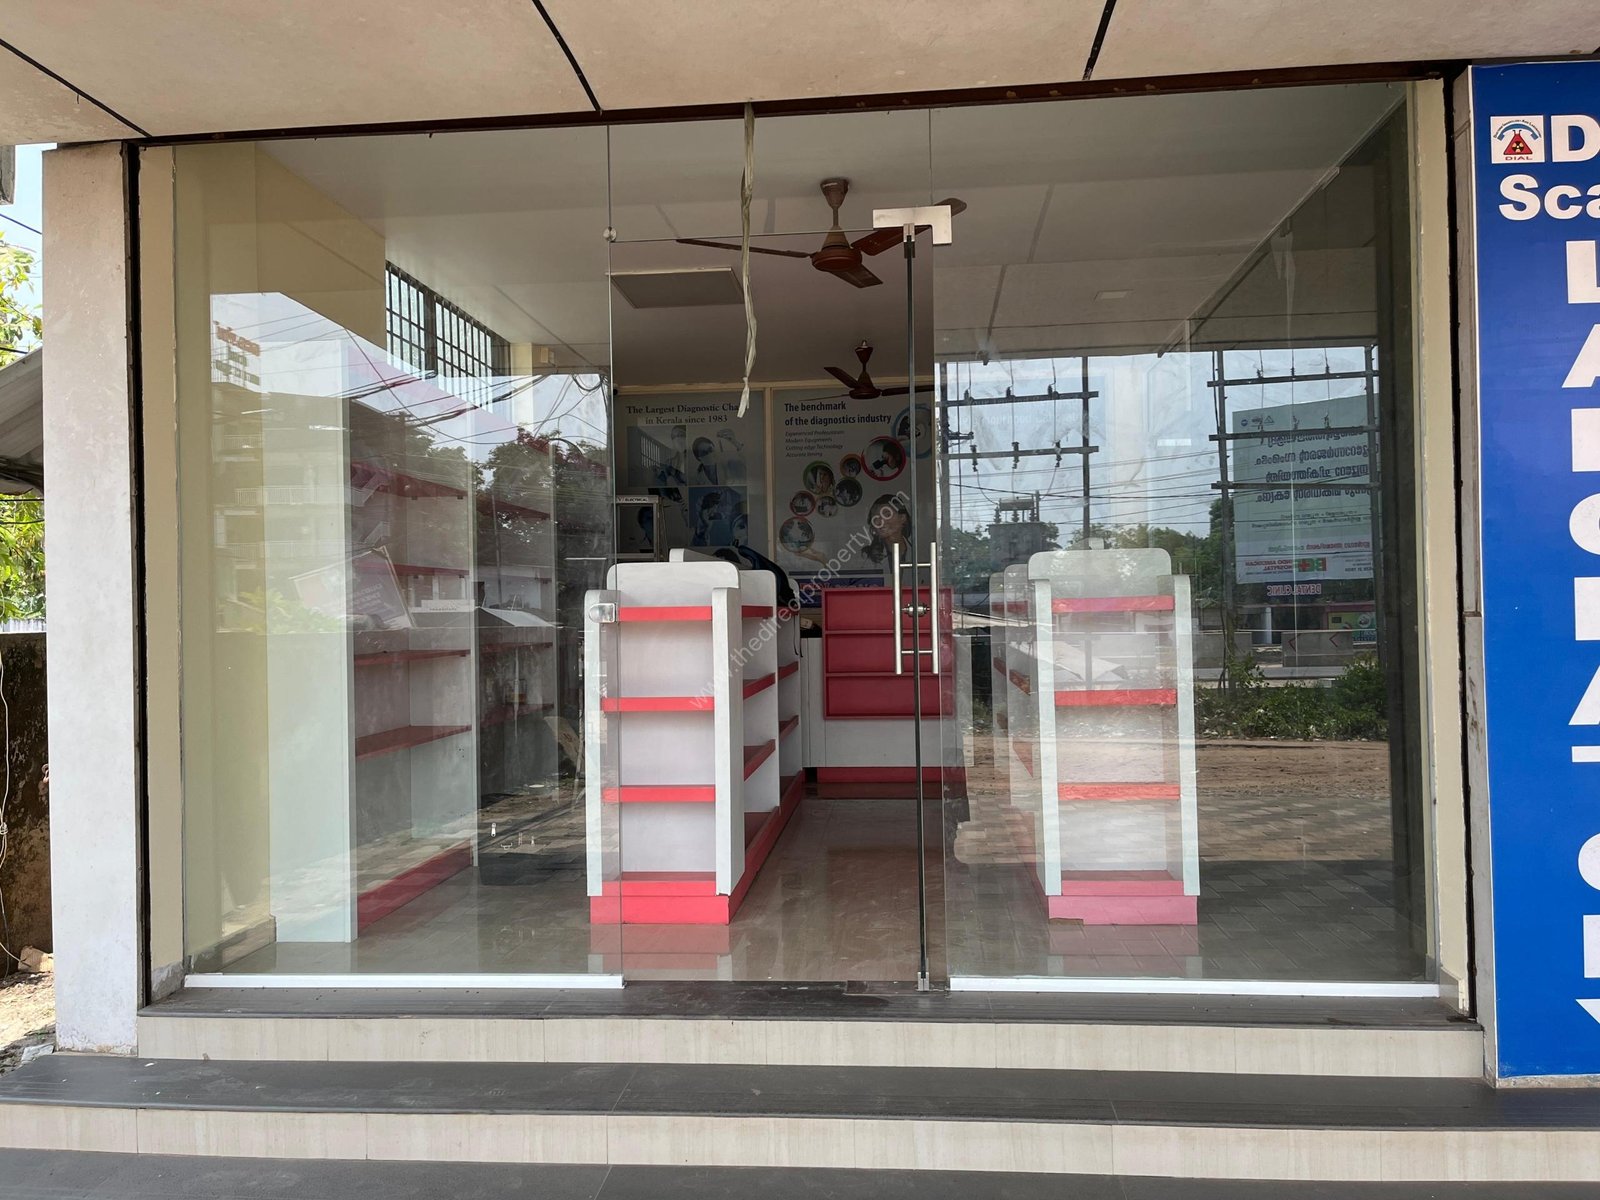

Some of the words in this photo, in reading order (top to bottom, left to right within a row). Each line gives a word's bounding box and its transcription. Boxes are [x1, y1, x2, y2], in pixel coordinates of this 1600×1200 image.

[626, 405, 642, 414] The
[645, 404, 675, 415] Largest
[677, 403, 720, 413] Diagnostic
[785, 403, 799, 412] The
[801, 401, 847, 412] benchmark
[645, 416, 654, 425] in
[656, 416, 681, 425] Kerala
[685, 416, 706, 424] since
[708, 414, 728, 423] 1983
[785, 416, 794, 426] of
[795, 416, 809, 425] the
[810, 414, 856, 427] diagnostics
[857, 413, 892, 425] industry
